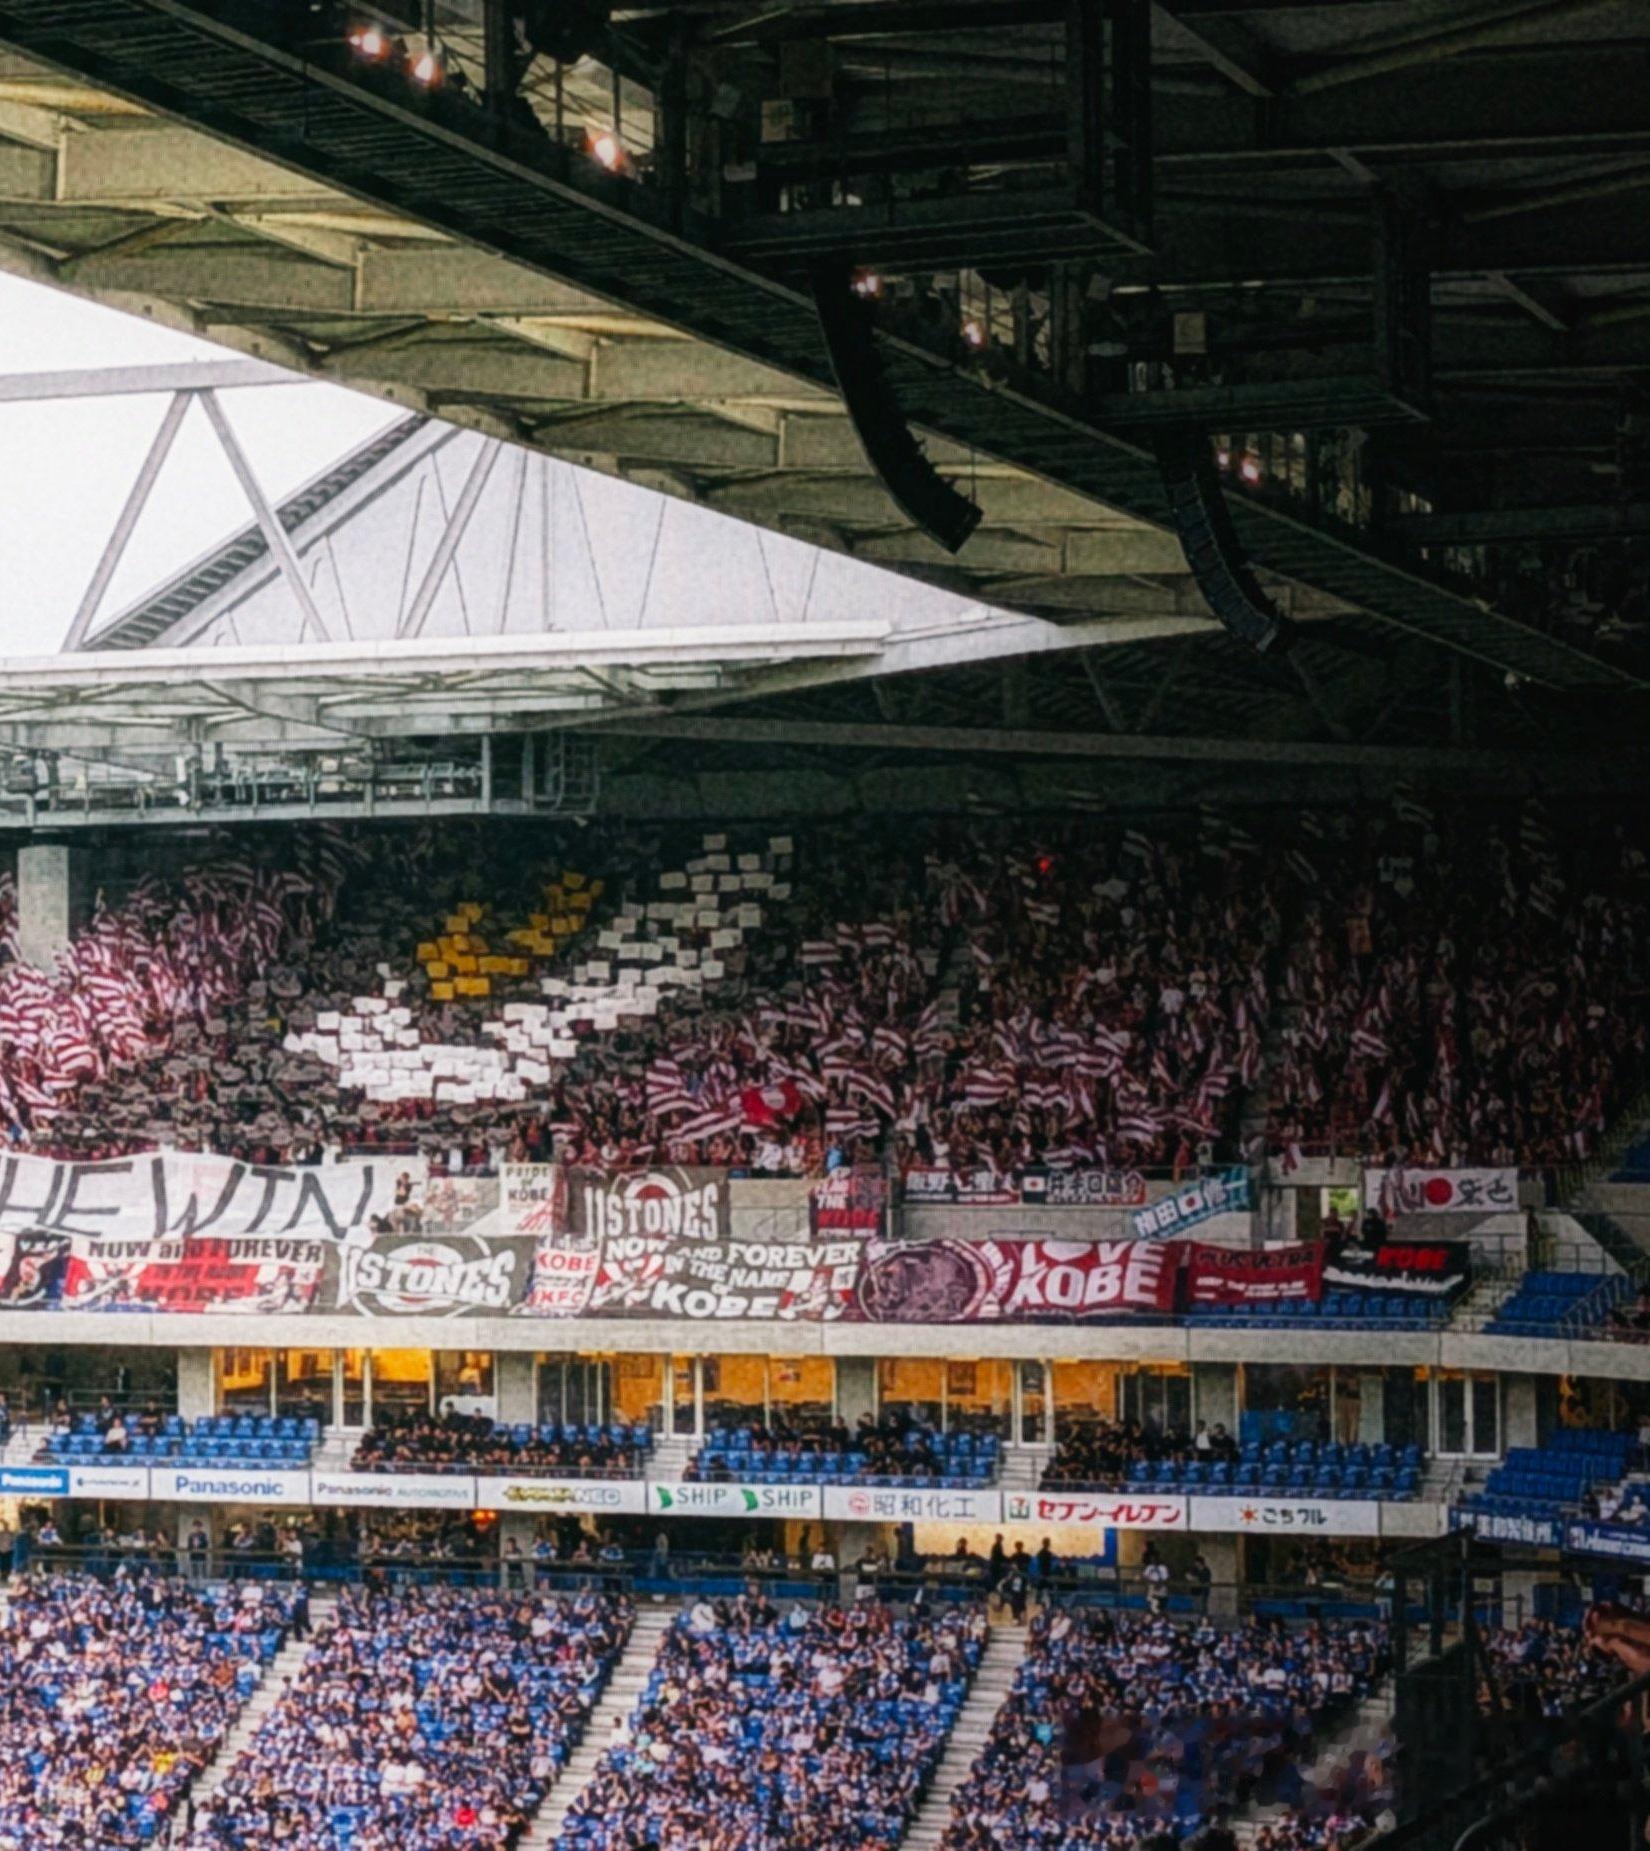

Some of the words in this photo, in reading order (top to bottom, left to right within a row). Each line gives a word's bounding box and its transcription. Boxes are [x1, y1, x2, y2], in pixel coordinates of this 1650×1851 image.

[149, 1155, 373, 1239] WIN
[605, 1237, 669, 1261] NOW
[726, 1241, 861, 1268] FOREVER
[650, 1280, 782, 1317] KOBE
[1005, 1263, 1161, 1312] KOBE
[174, 1475, 285, 1496] Panasonic
[317, 1482, 392, 1498] Panasonic
[676, 1486, 728, 1506] SHIP
[761, 1488, 813, 1508] SHIP
[873, 1494, 977, 1519] 昭和化工
